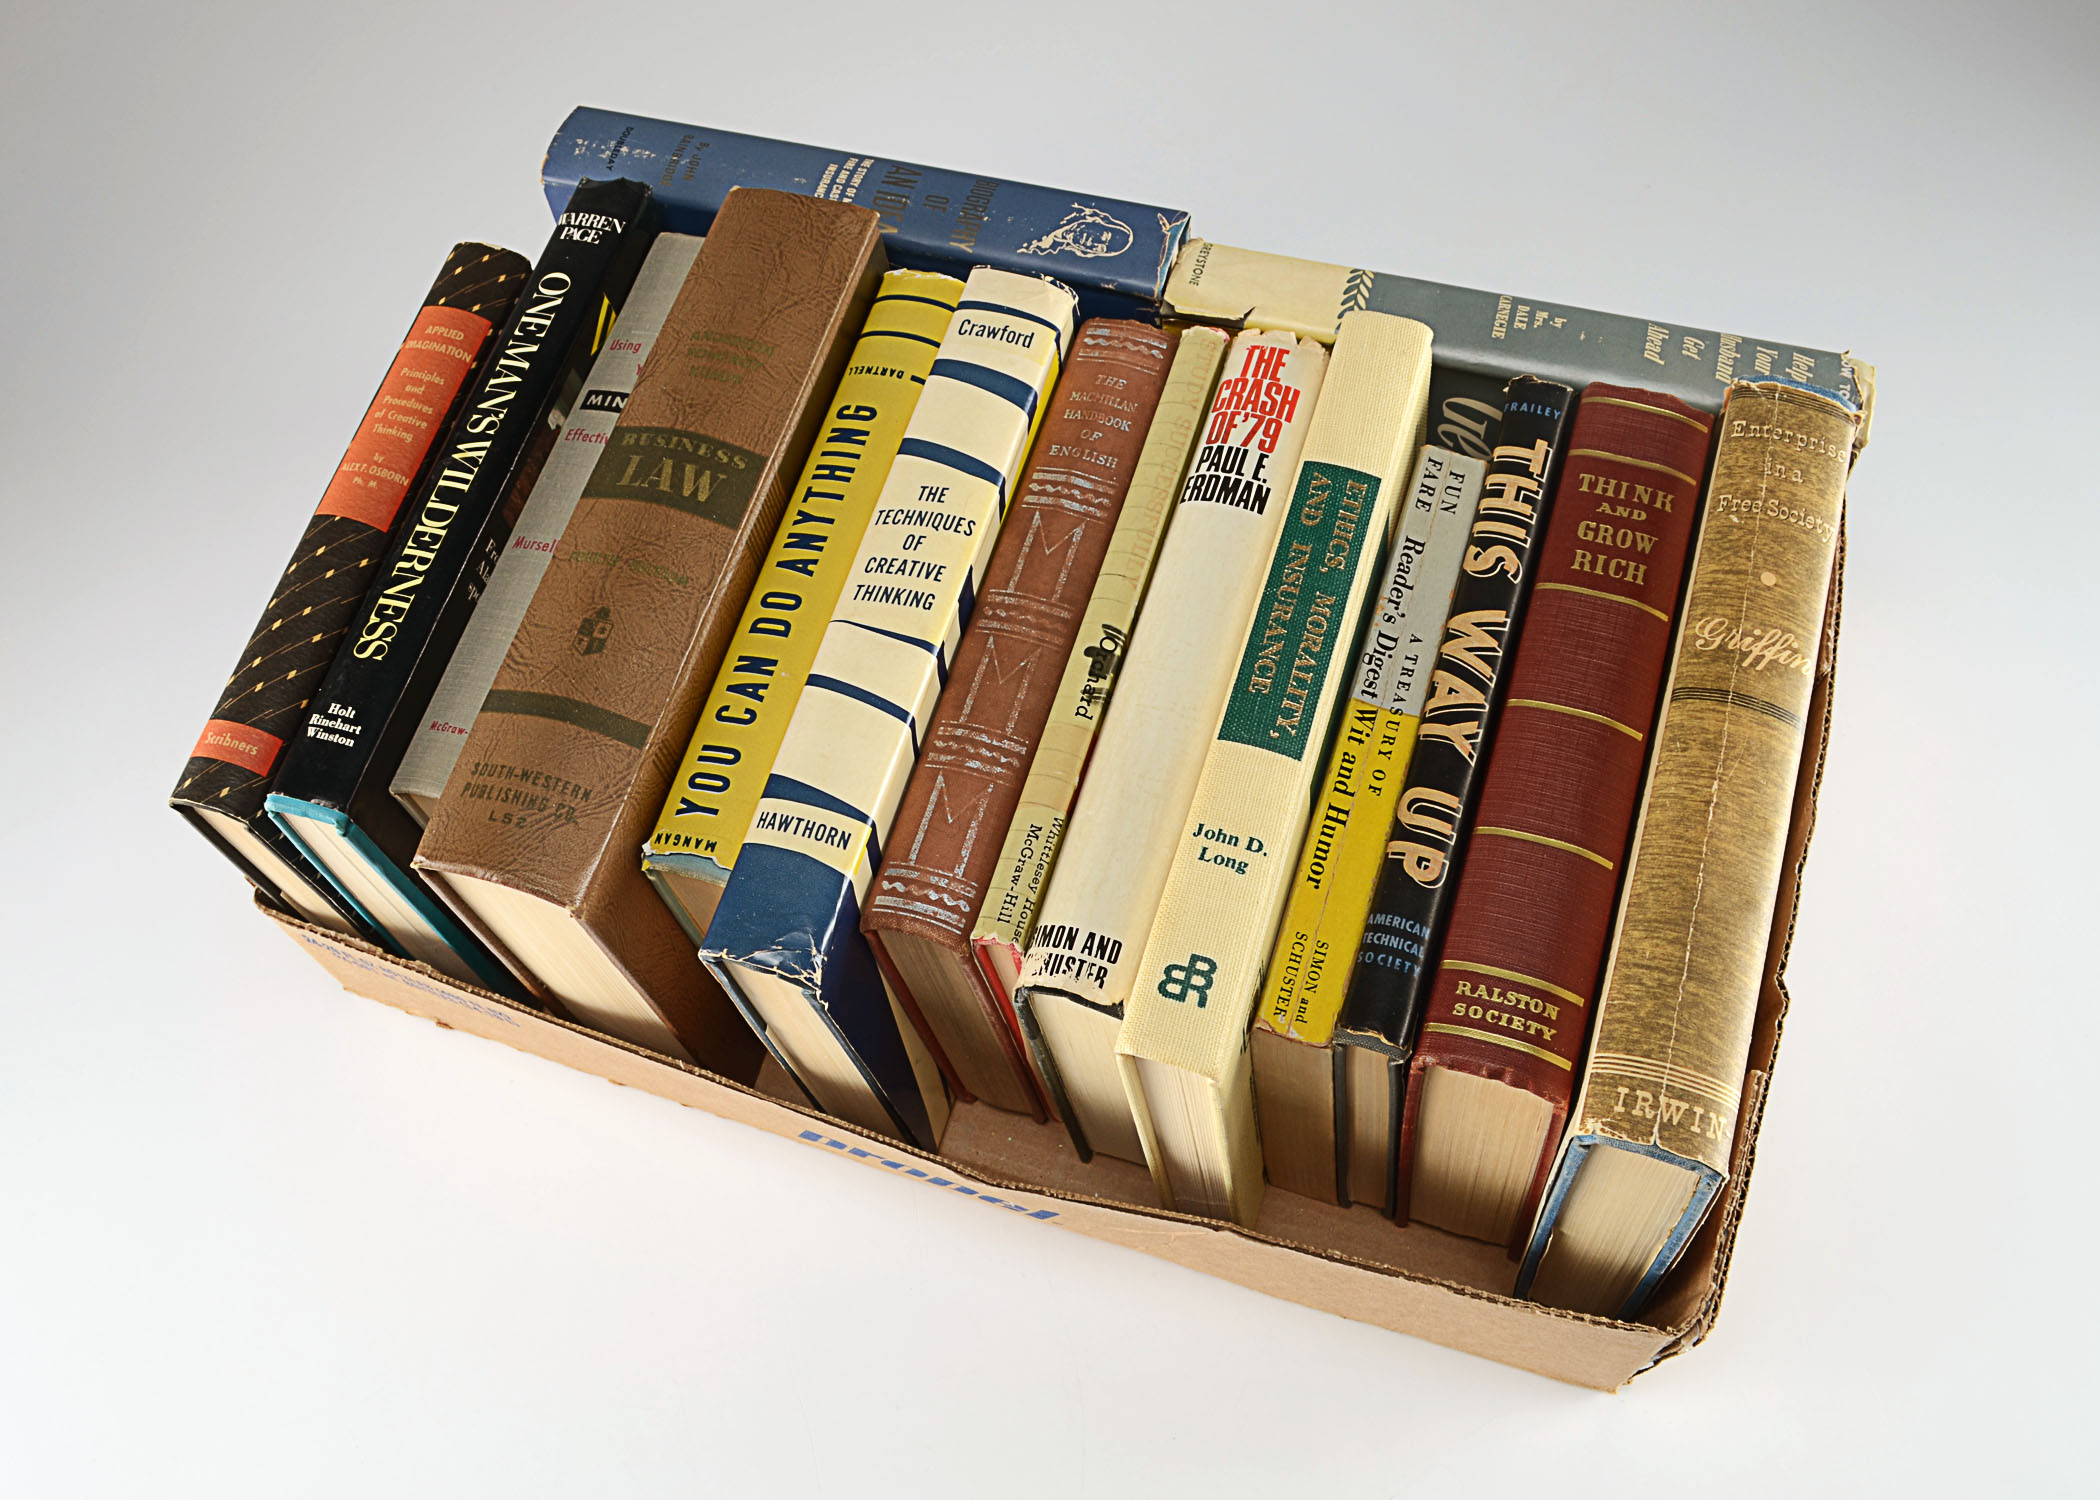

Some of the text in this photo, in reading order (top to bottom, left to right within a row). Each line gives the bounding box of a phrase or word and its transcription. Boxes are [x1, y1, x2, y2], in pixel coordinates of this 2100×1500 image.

[881, 164, 923, 190] AN
[923, 194, 950, 213] OF
[949, 178, 1000, 253] BIOGRAPHY
[559, 226, 603, 245] PAGE
[1189, 242, 1213, 286] GREYSTONE
[1491, 295, 1513, 339] CARNEGIE
[1514, 304, 1530, 330] DALE
[1533, 310, 1549, 328] Mrs.
[1550, 316, 1568, 328] by
[425, 324, 464, 341] APPLIED
[610, 339, 642, 353] Using
[958, 318, 1034, 349] Crawford
[1644, 322, 1670, 366] Ahead
[405, 339, 473, 363] IMAGINATION
[1682, 336, 1705, 360] Get
[1755, 346, 1779, 375] Your
[400, 367, 446, 386] Principles
[848, 366, 904, 380] DARTNELL
[1240, 345, 1290, 382] THE
[405, 384, 425, 395] and
[1095, 374, 1128, 390] THE
[383, 394, 434, 415] Procedures
[1069, 391, 1139, 413] MACMILLAN
[1212, 377, 1301, 423] CRASH
[1503, 401, 1561, 420] FRAILEY
[372, 423, 415, 443] Thinking
[374, 409, 428, 430] of Creative
[1064, 409, 1132, 432] HANDBOOK
[1206, 411, 1283, 453] OF '79
[1080, 429, 1103, 441] OF
[1730, 420, 1847, 463] Enterprise
[373, 452, 384, 463] by
[621, 433, 746, 469] BUSINESS
[1049, 444, 1119, 468] ENGLISH
[1195, 445, 1270, 483] PAUL E.
[353, 272, 571, 662] ONE MAN'S WILDERNESS
[368, 465, 409, 487] OSBORN
[616, 454, 727, 502] LAW
[1764, 456, 1805, 484] in a
[918, 485, 949, 503] THE
[1180, 474, 1271, 515] ERDMAN
[1415, 456, 1443, 512] FARE
[1440, 470, 1466, 515] FUN
[1578, 473, 1675, 512] THINK
[875, 509, 976, 537] TECHNIQUES
[1596, 502, 1647, 521] AND
[1716, 494, 1835, 543] Free Society
[902, 534, 926, 551] OF
[1577, 520, 1659, 555] GROW
[864, 557, 946, 583] CREATIVE
[1571, 549, 1647, 585] RICH
[853, 584, 936, 611] THINKING
[1248, 472, 1331, 695] AND INSURANCE
[675, 404, 878, 817] YOU CAN DO ANYTHING
[1269, 479, 1368, 739] ETHICS, MORALITY,
[1361, 535, 1426, 700] Reader's Digest
[1695, 617, 1813, 676] Griffin
[1386, 438, 1553, 889] THIS WAY UP
[309, 713, 362, 735] Rinehart
[328, 703, 356, 719] Holt
[1368, 634, 1423, 796] A TREASURY OF
[205, 731, 258, 756] Scribners
[307, 726, 355, 748] Winston
[471, 762, 592, 802] SOUTH-WESTERN
[460, 783, 549, 812] PUBLISHING
[1306, 709, 1378, 890] Wit and Humor
[654, 832, 718, 853] MANGAN
[756, 811, 851, 850] HAWTHORN
[1193, 823, 1268, 856] John D.
[1028, 817, 1064, 894] Whittlesey
[1198, 846, 1249, 875] Long
[997, 824, 1042, 923] McGraw-Hill
[1367, 913, 1430, 939] AMERICAN
[1081, 931, 1123, 965] AND
[1362, 932, 1424, 957] TECHNICAL
[1273, 931, 1309, 1017] SCHUSTER
[1358, 951, 1421, 977] SOCIETY
[1295, 940, 1329, 1024] SIMON and
[1456, 980, 1560, 1021] RALSTON
[1452, 1002, 1557, 1041] SOCIETY
[1614, 1086, 1727, 1143] IRWIN
